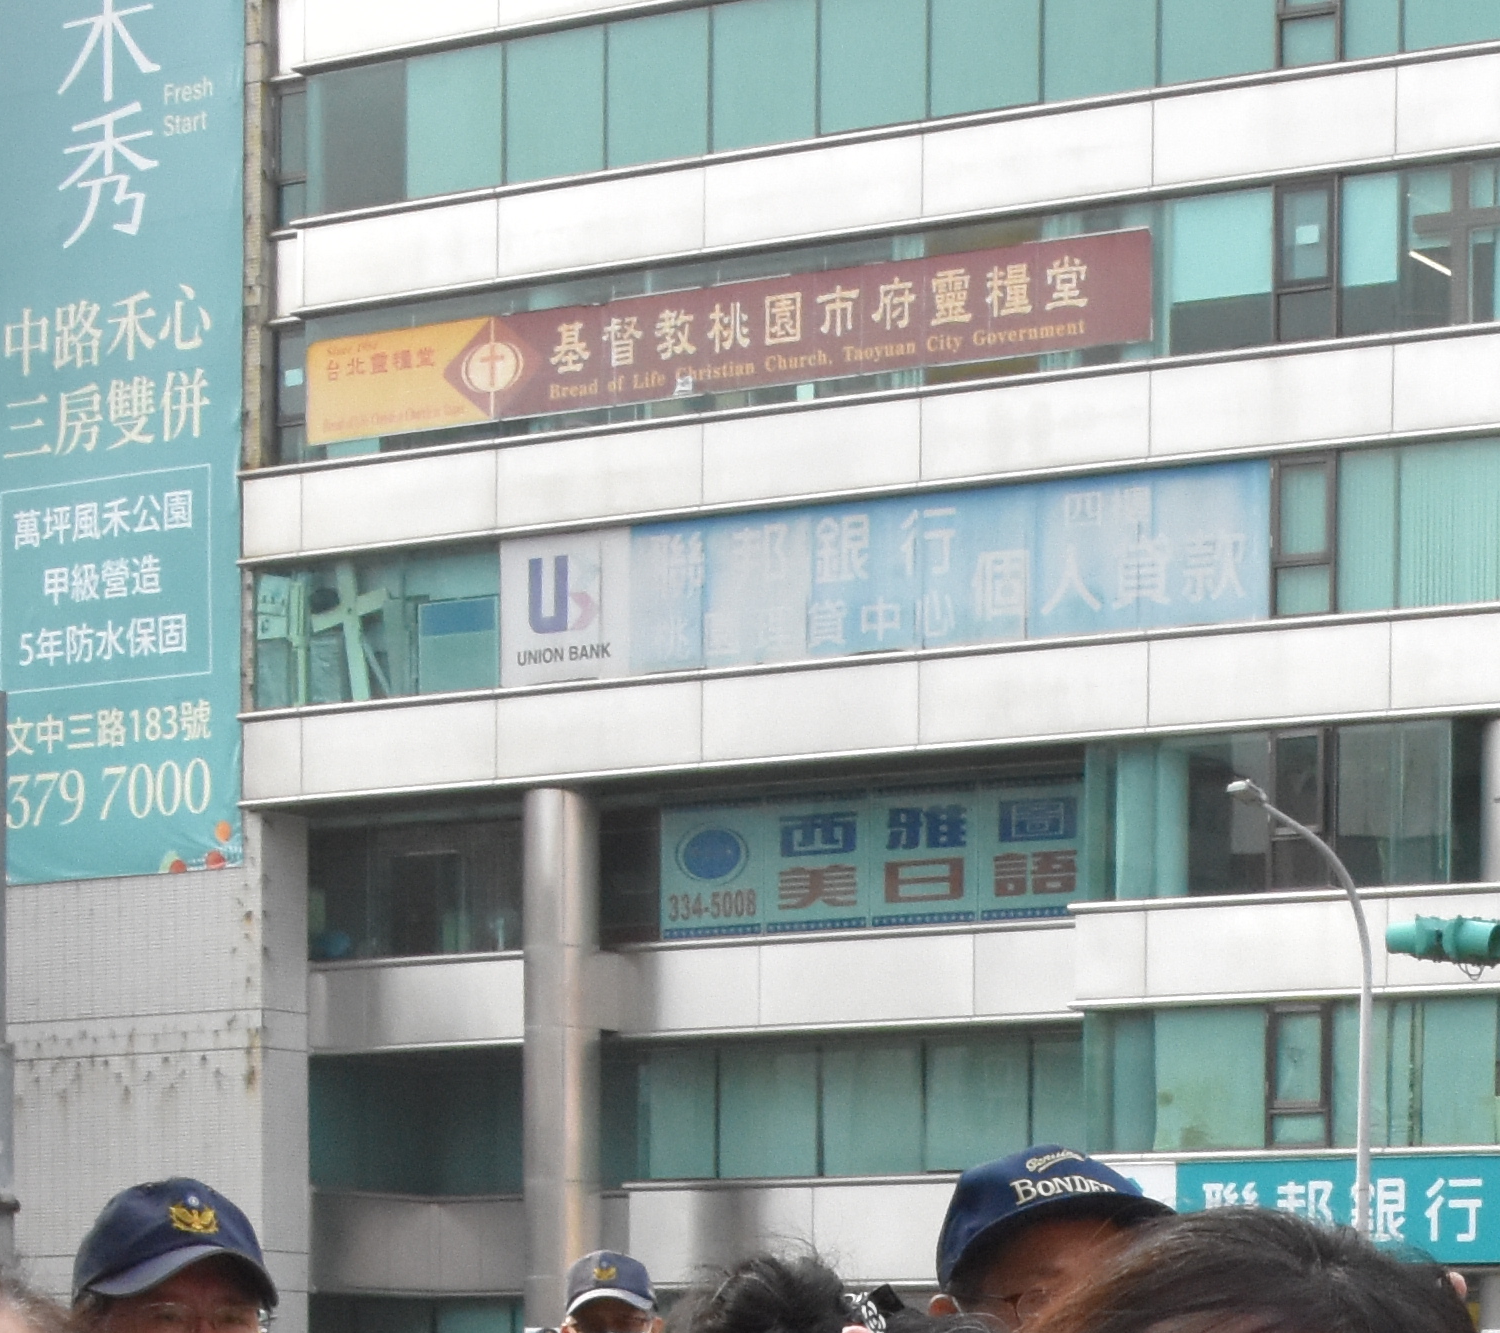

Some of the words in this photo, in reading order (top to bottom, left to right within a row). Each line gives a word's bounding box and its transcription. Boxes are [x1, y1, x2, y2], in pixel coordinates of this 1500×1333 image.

[163, 77, 214, 106] Fresh
[163, 110, 209, 137] Start
[4, 283, 213, 378] 中路禾心
[550, 255, 1090, 374] 基督教桃園市府靈糧堂
[550, 378, 600, 400] Bread
[607, 377, 627, 395] of
[632, 370, 667, 390] Life
[843, 337, 917, 366] Taoyuan
[926, 333, 963, 356] City
[972, 318, 1086, 347] Government
[3, 367, 212, 459] 三房雙併
[13, 489, 193, 550] 萬坪風禾公園
[43, 553, 162, 607] 甲級營造
[19, 613, 188, 668] 5年防水保固
[516, 650, 564, 668] UNION
[568, 642, 612, 662] BANK
[6, 699, 211, 758] 文中三路183號
[6, 767, 86, 830] 379
[100, 756, 212, 822] 7000
[668, 888, 757, 922] 334-5008
[777, 849, 1077, 911] 美日語
